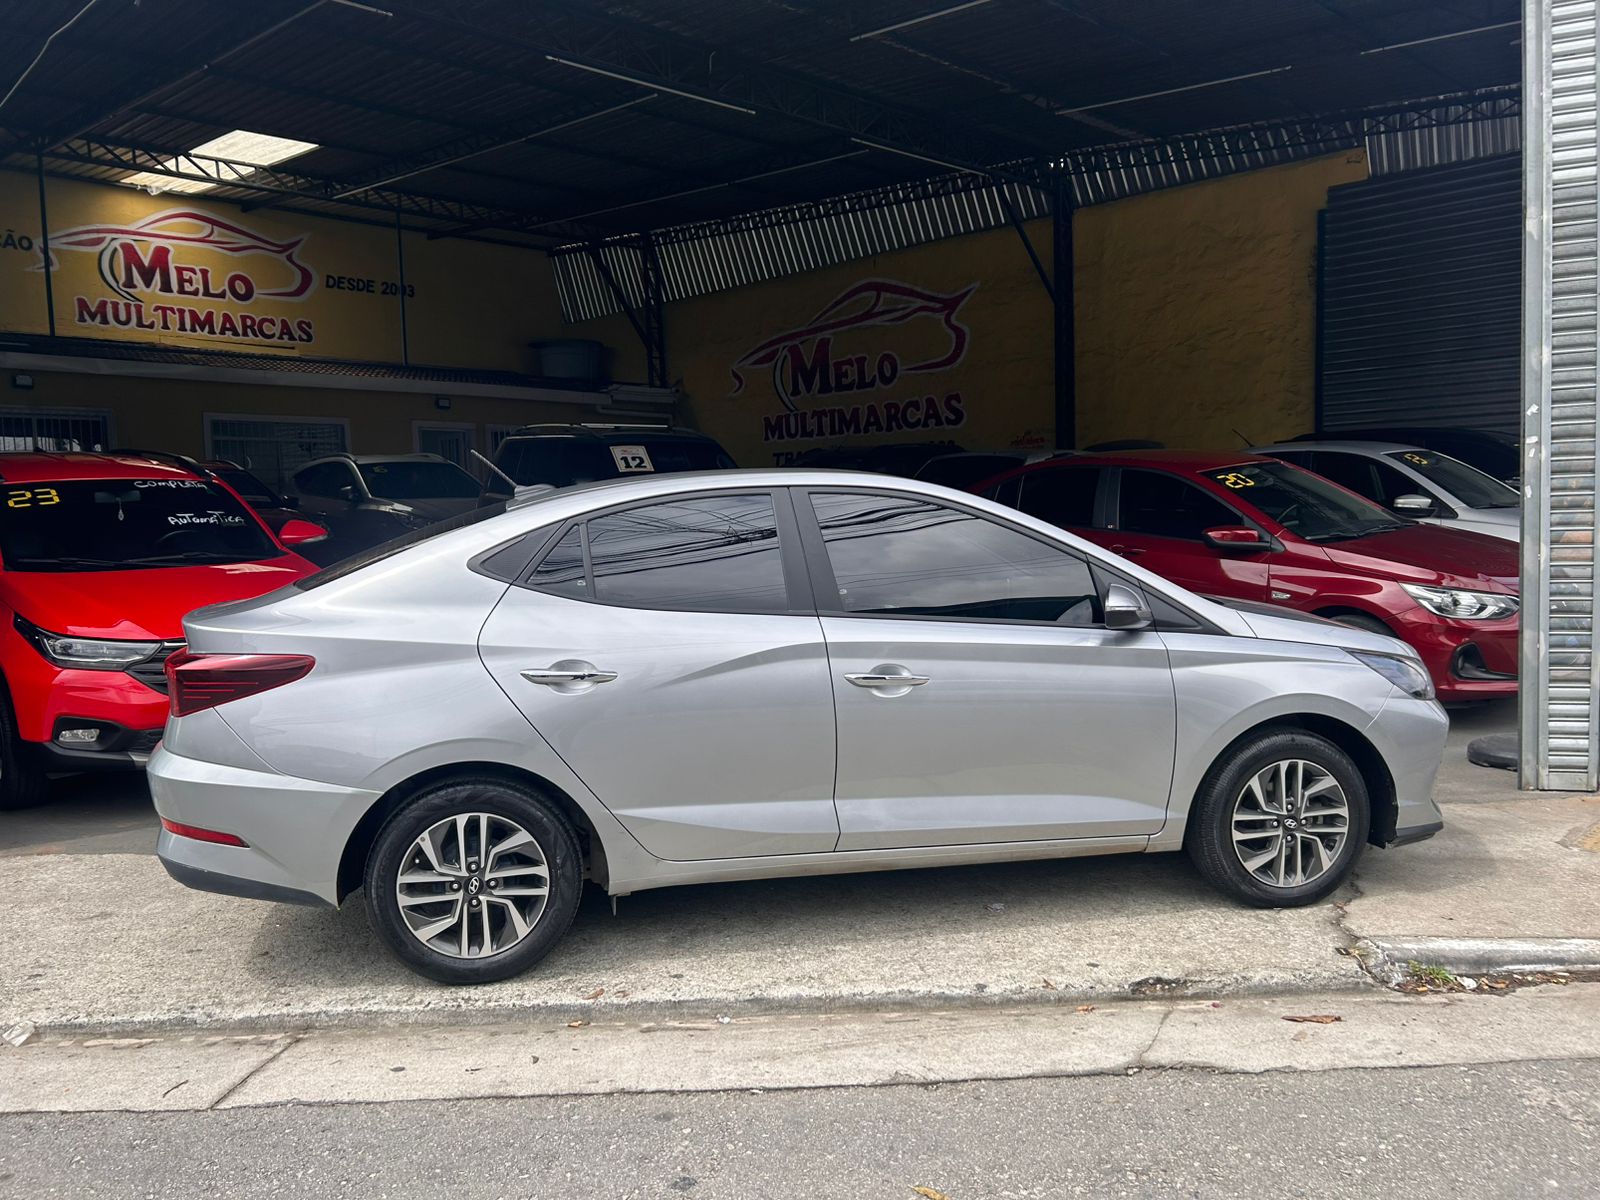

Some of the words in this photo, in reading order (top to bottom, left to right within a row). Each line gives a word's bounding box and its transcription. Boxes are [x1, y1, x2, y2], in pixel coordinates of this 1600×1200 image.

[120, 240, 256, 302] MELO
[325, 275, 375, 293] DESDE
[75, 297, 313, 343] MULTIMARCAS
[787, 337, 898, 397] MELO
[764, 393, 965, 441] MULTIMARCAS
[620, 456, 647, 469] 12
[1216, 473, 1255, 488] 20
[8, 488, 60, 507] 23
